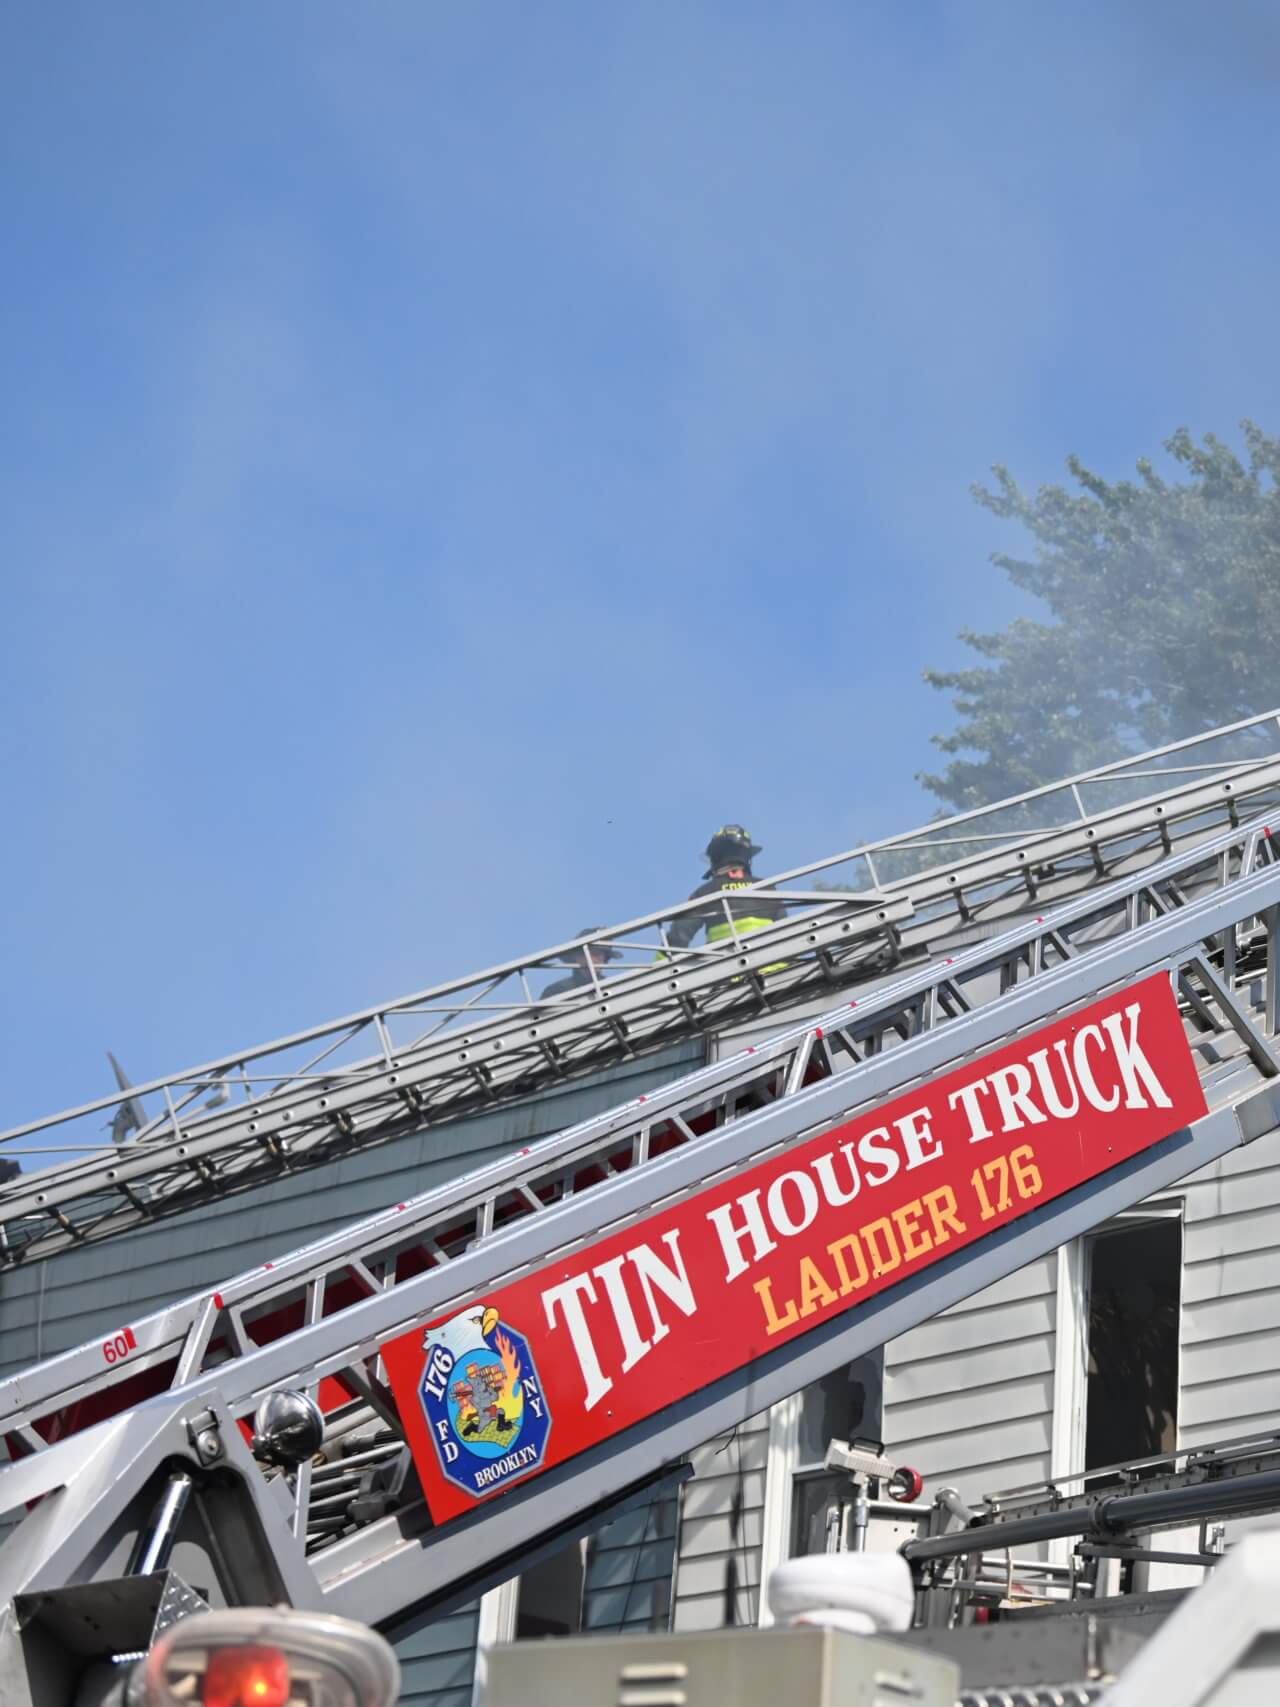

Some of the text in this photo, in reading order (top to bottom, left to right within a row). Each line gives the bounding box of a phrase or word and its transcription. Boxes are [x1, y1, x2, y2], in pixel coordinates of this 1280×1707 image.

[541, 1002, 1174, 1411] TIN HOUSE TRUCK
[753, 1144, 1043, 1335] LADDER 176
[103, 1335, 128, 1363] 60
[425, 1350, 454, 1402] 176
[474, 1443, 538, 1488] BROOKLYN
